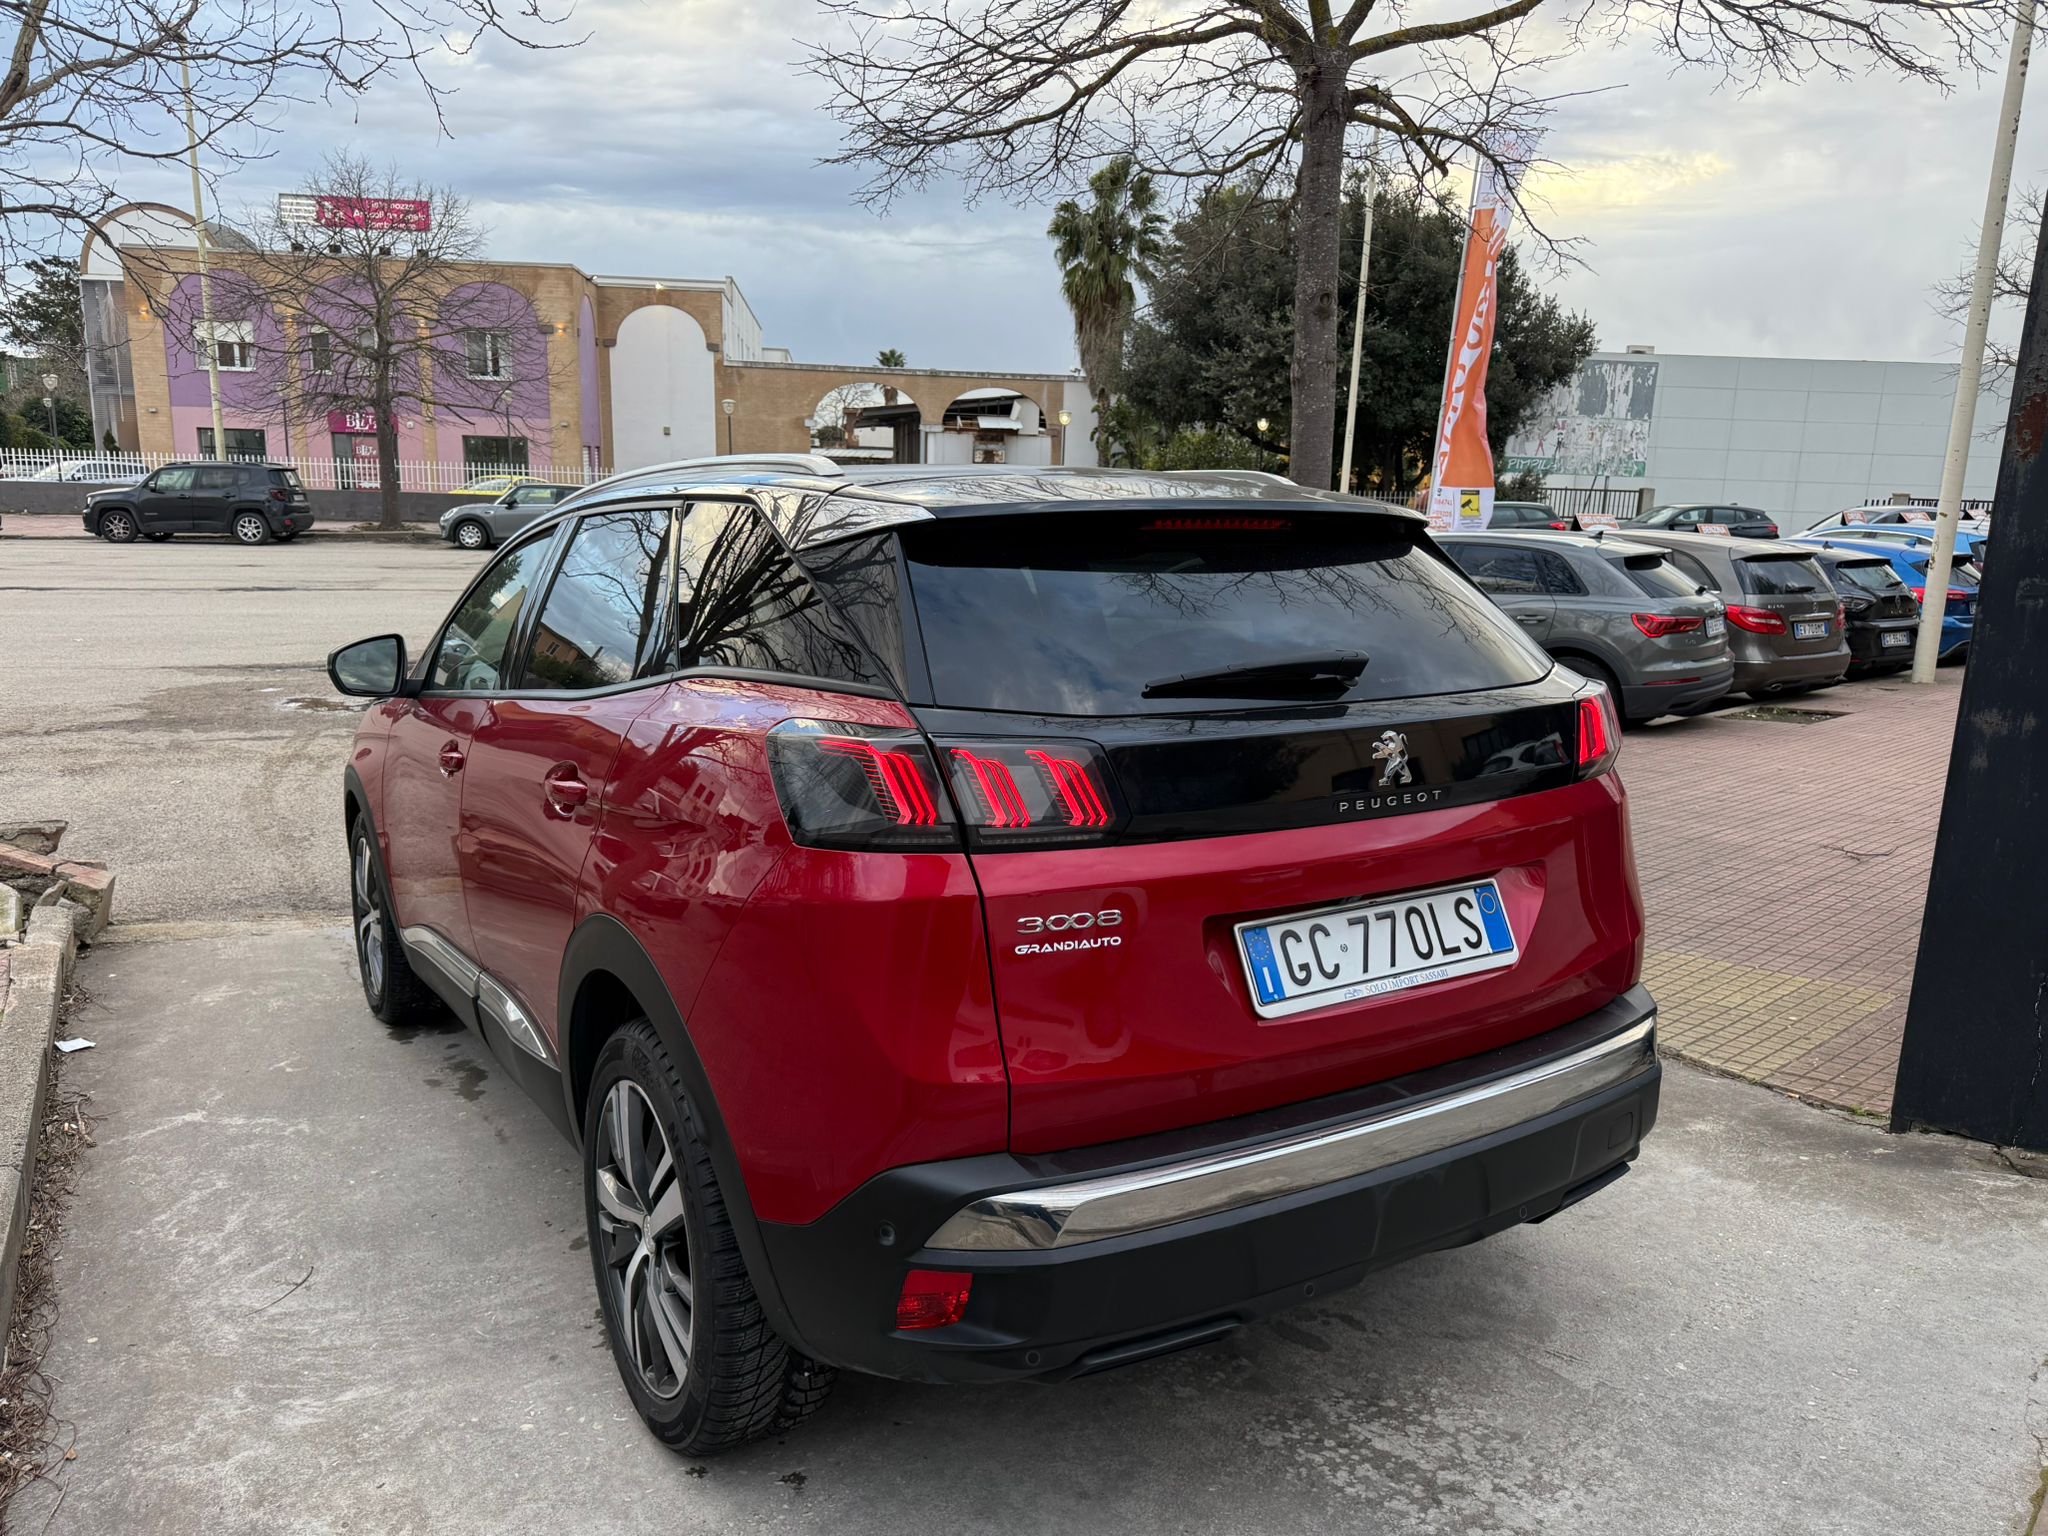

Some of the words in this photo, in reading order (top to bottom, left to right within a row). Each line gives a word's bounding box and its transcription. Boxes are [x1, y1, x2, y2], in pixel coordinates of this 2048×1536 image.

[1339, 789, 1442, 813] PEUGEOT
[1016, 909, 1123, 935] 3008
[1014, 936, 1122, 955] GRANDIAUTO
[1279, 923, 1340, 987] GC
[1347, 896, 1484, 975] 770LS
[1262, 966, 1274, 993] I
[1364, 981, 1388, 994] SOLO
[1388, 975, 1419, 989] IMPORT
[1419, 969, 1449, 984] SASSARI
